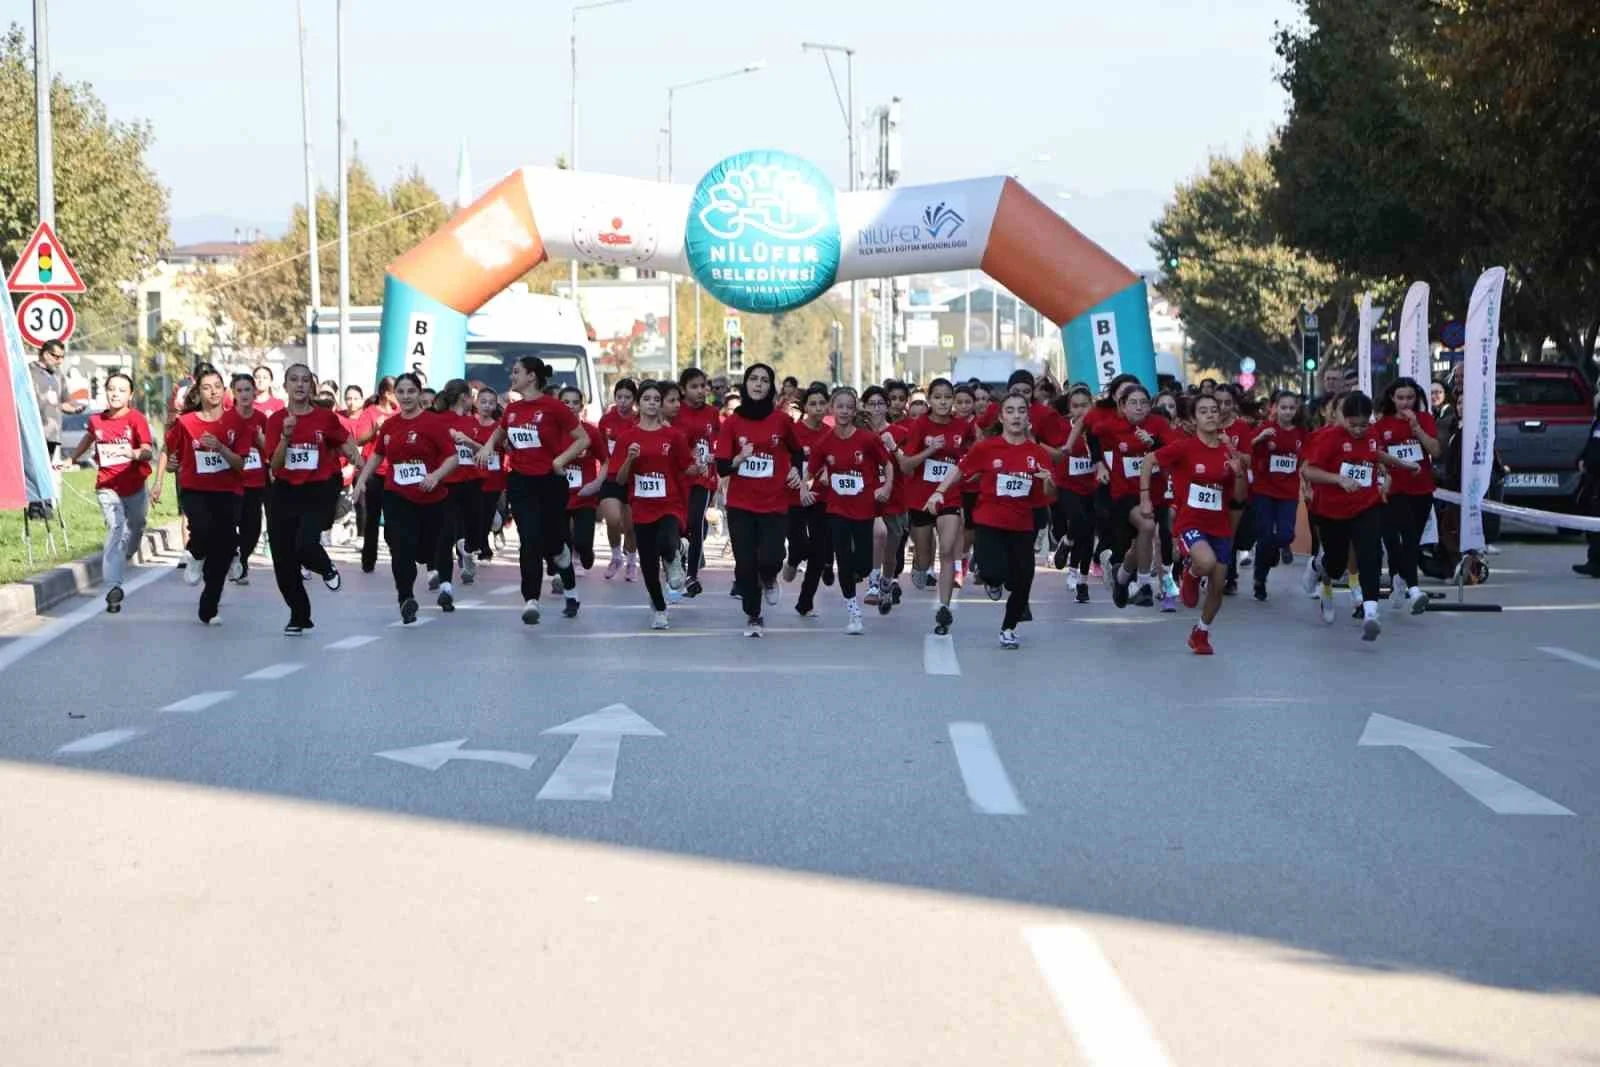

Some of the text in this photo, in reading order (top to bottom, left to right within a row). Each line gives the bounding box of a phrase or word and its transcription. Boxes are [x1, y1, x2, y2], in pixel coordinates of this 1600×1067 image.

[710, 241, 819, 263] NİLÜFER
[712, 265, 816, 281] BELEDİYESİ
[30, 307, 63, 331] 30
[512, 432, 533, 443] 1021
[745, 460, 767, 471] 1017
[400, 466, 425, 480] 1022
[639, 480, 660, 491] 1031
[1198, 492, 1216, 503] 921
